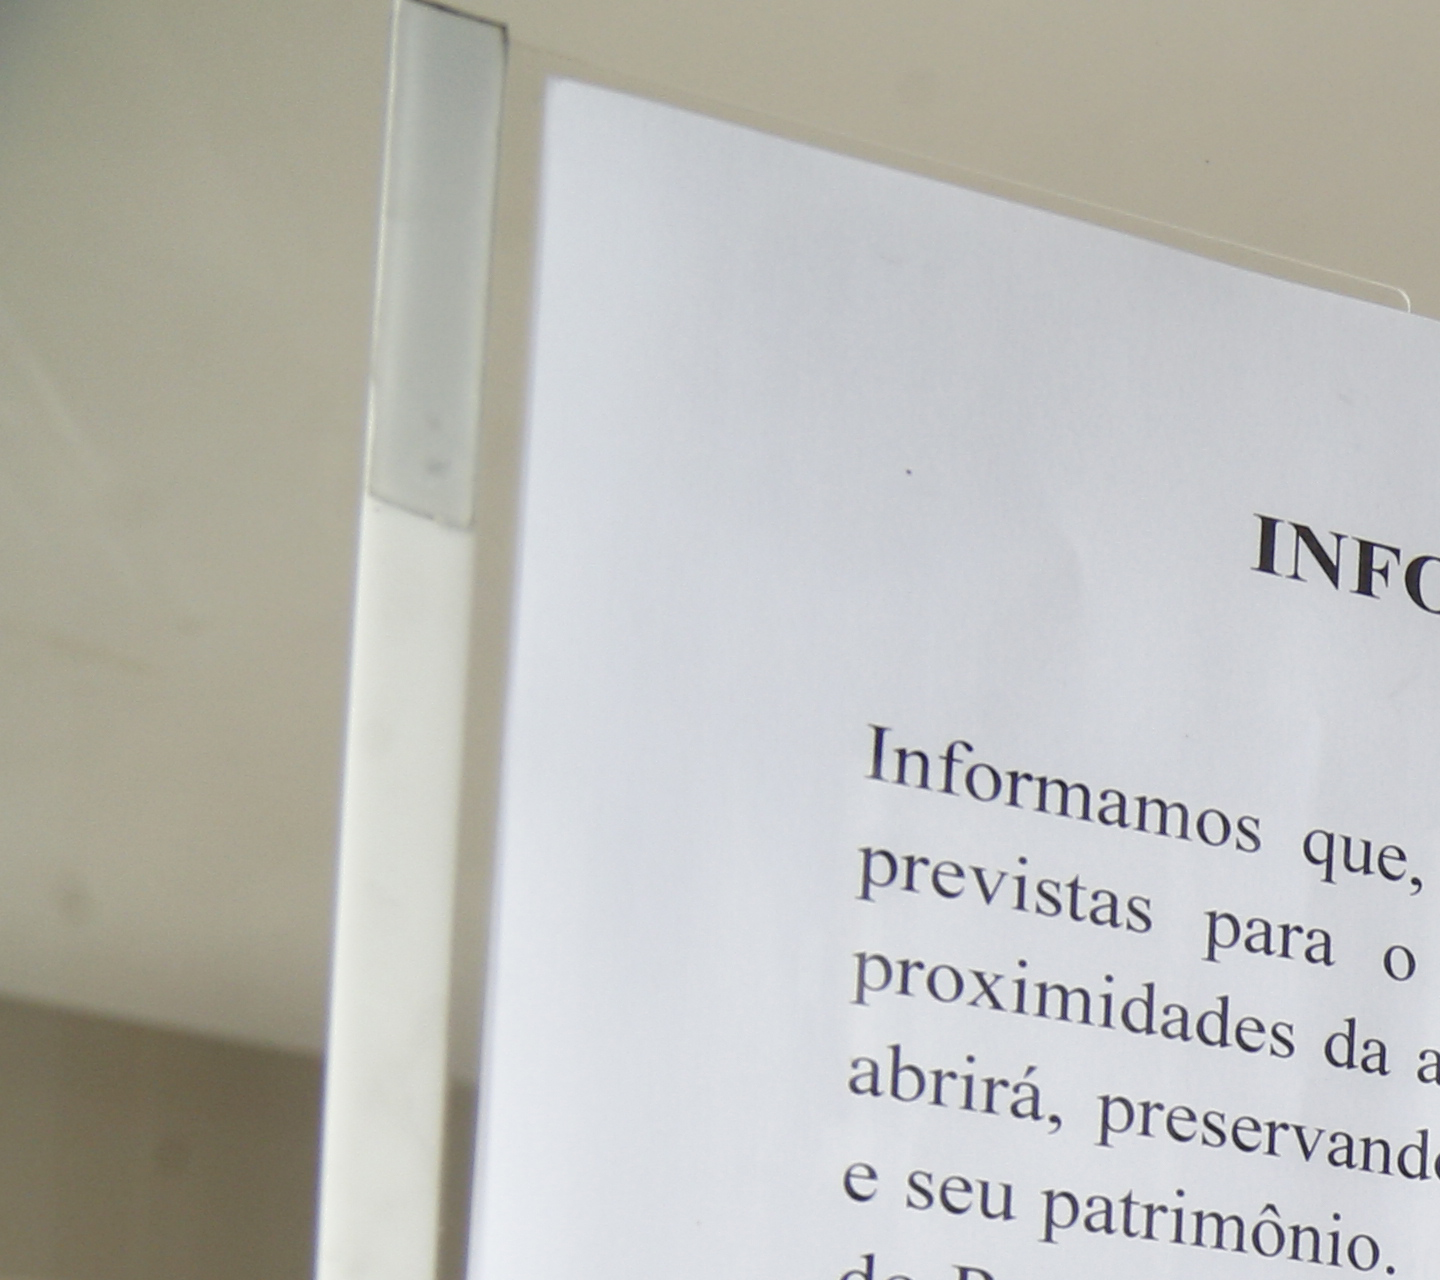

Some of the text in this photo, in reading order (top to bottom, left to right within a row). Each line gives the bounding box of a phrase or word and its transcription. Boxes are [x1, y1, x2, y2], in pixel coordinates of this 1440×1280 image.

[865, 721, 1263, 855] Informamos
[1300, 827, 1424, 897] que,
[855, 844, 1154, 935] previstas
[1199, 908, 1337, 968] para
[1381, 942, 1418, 983] o
[850, 949, 1296, 1060] proximidades
[1321, 1014, 1392, 1078] da
[846, 1041, 1063, 1136] abrirá,
[841, 1160, 879, 1204] e
[904, 1168, 1017, 1223] seu
[1037, 1187, 1399, 1278] patrimônio.
